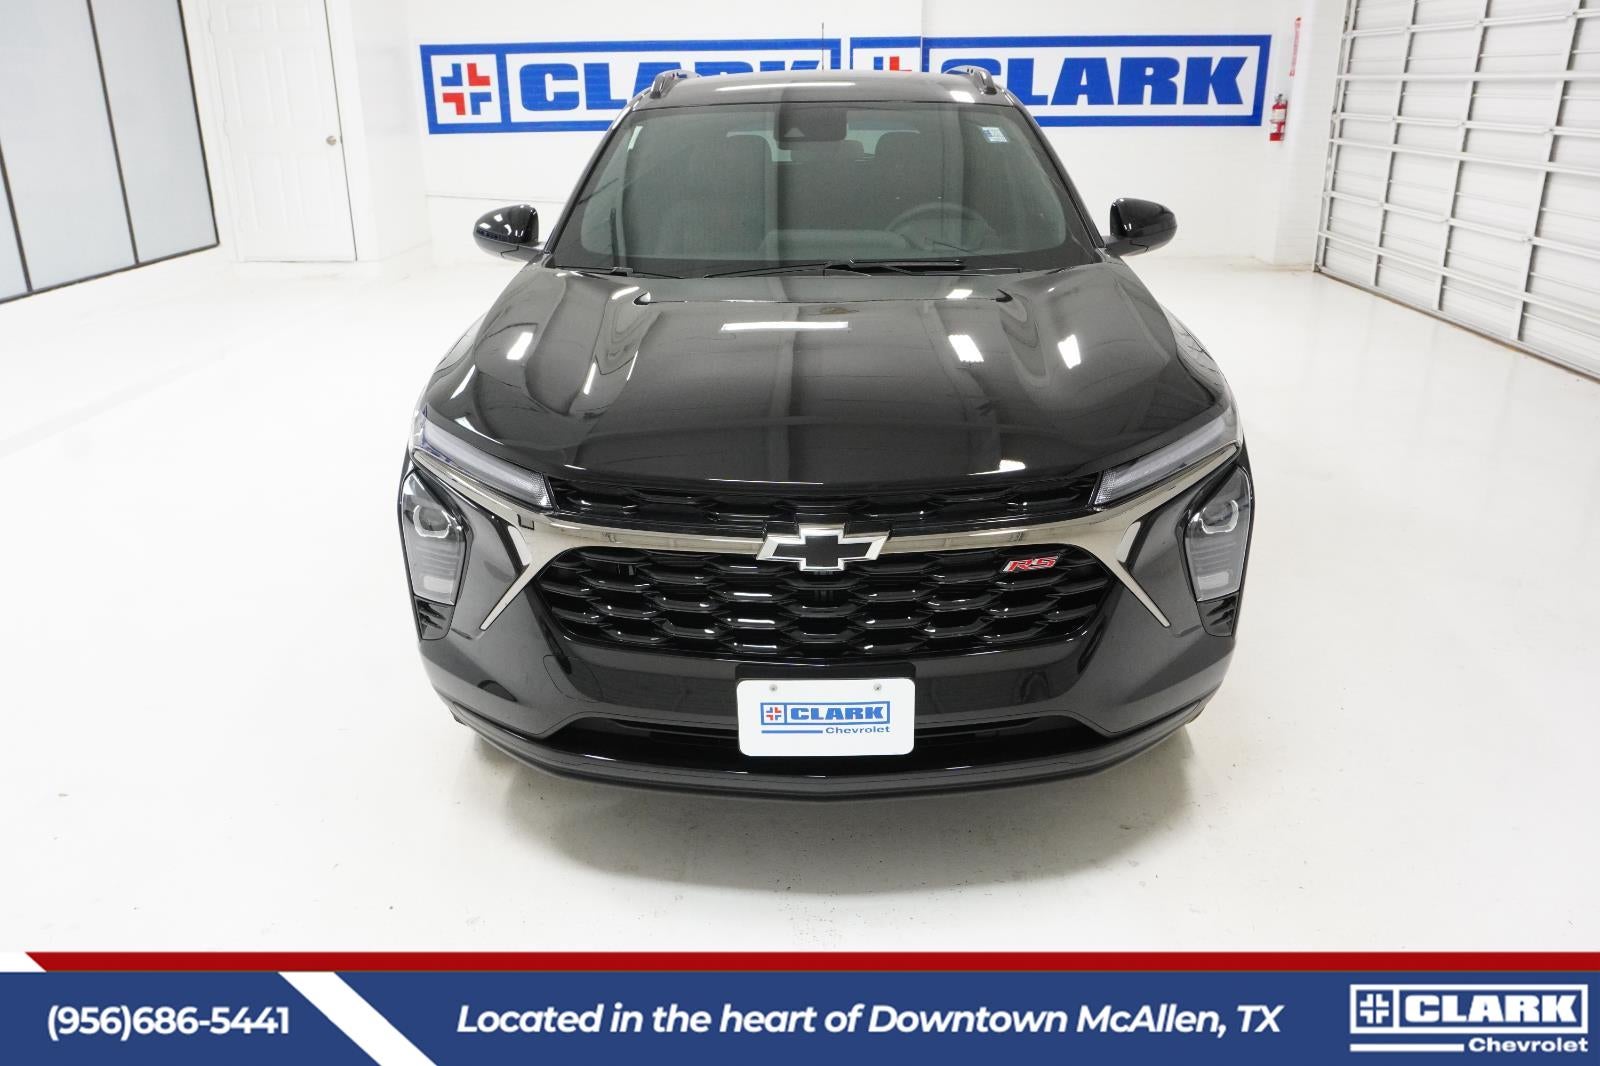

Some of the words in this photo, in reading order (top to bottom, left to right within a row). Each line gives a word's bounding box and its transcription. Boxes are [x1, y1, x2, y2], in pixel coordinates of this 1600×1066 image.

[1003, 556, 1059, 572] RS
[790, 706, 884, 721] CLARK
[825, 725, 891, 735] Chevrolet
